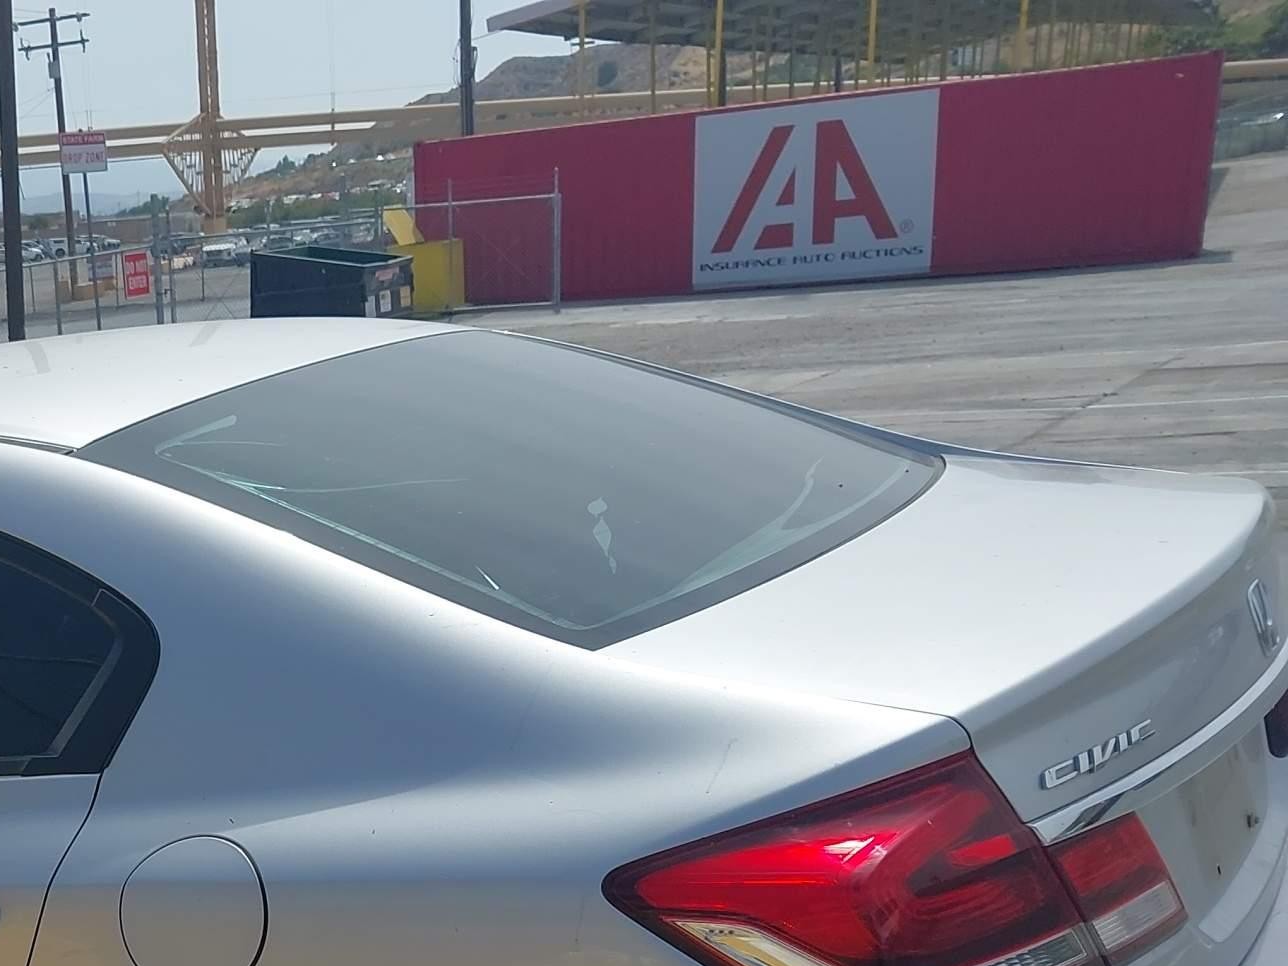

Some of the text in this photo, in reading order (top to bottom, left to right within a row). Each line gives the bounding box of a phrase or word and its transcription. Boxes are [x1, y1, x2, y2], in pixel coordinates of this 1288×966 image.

[700, 245, 924, 273] INSURANCE AUTO AUCTIONS
[1040, 719, 1155, 789] CIVIC
